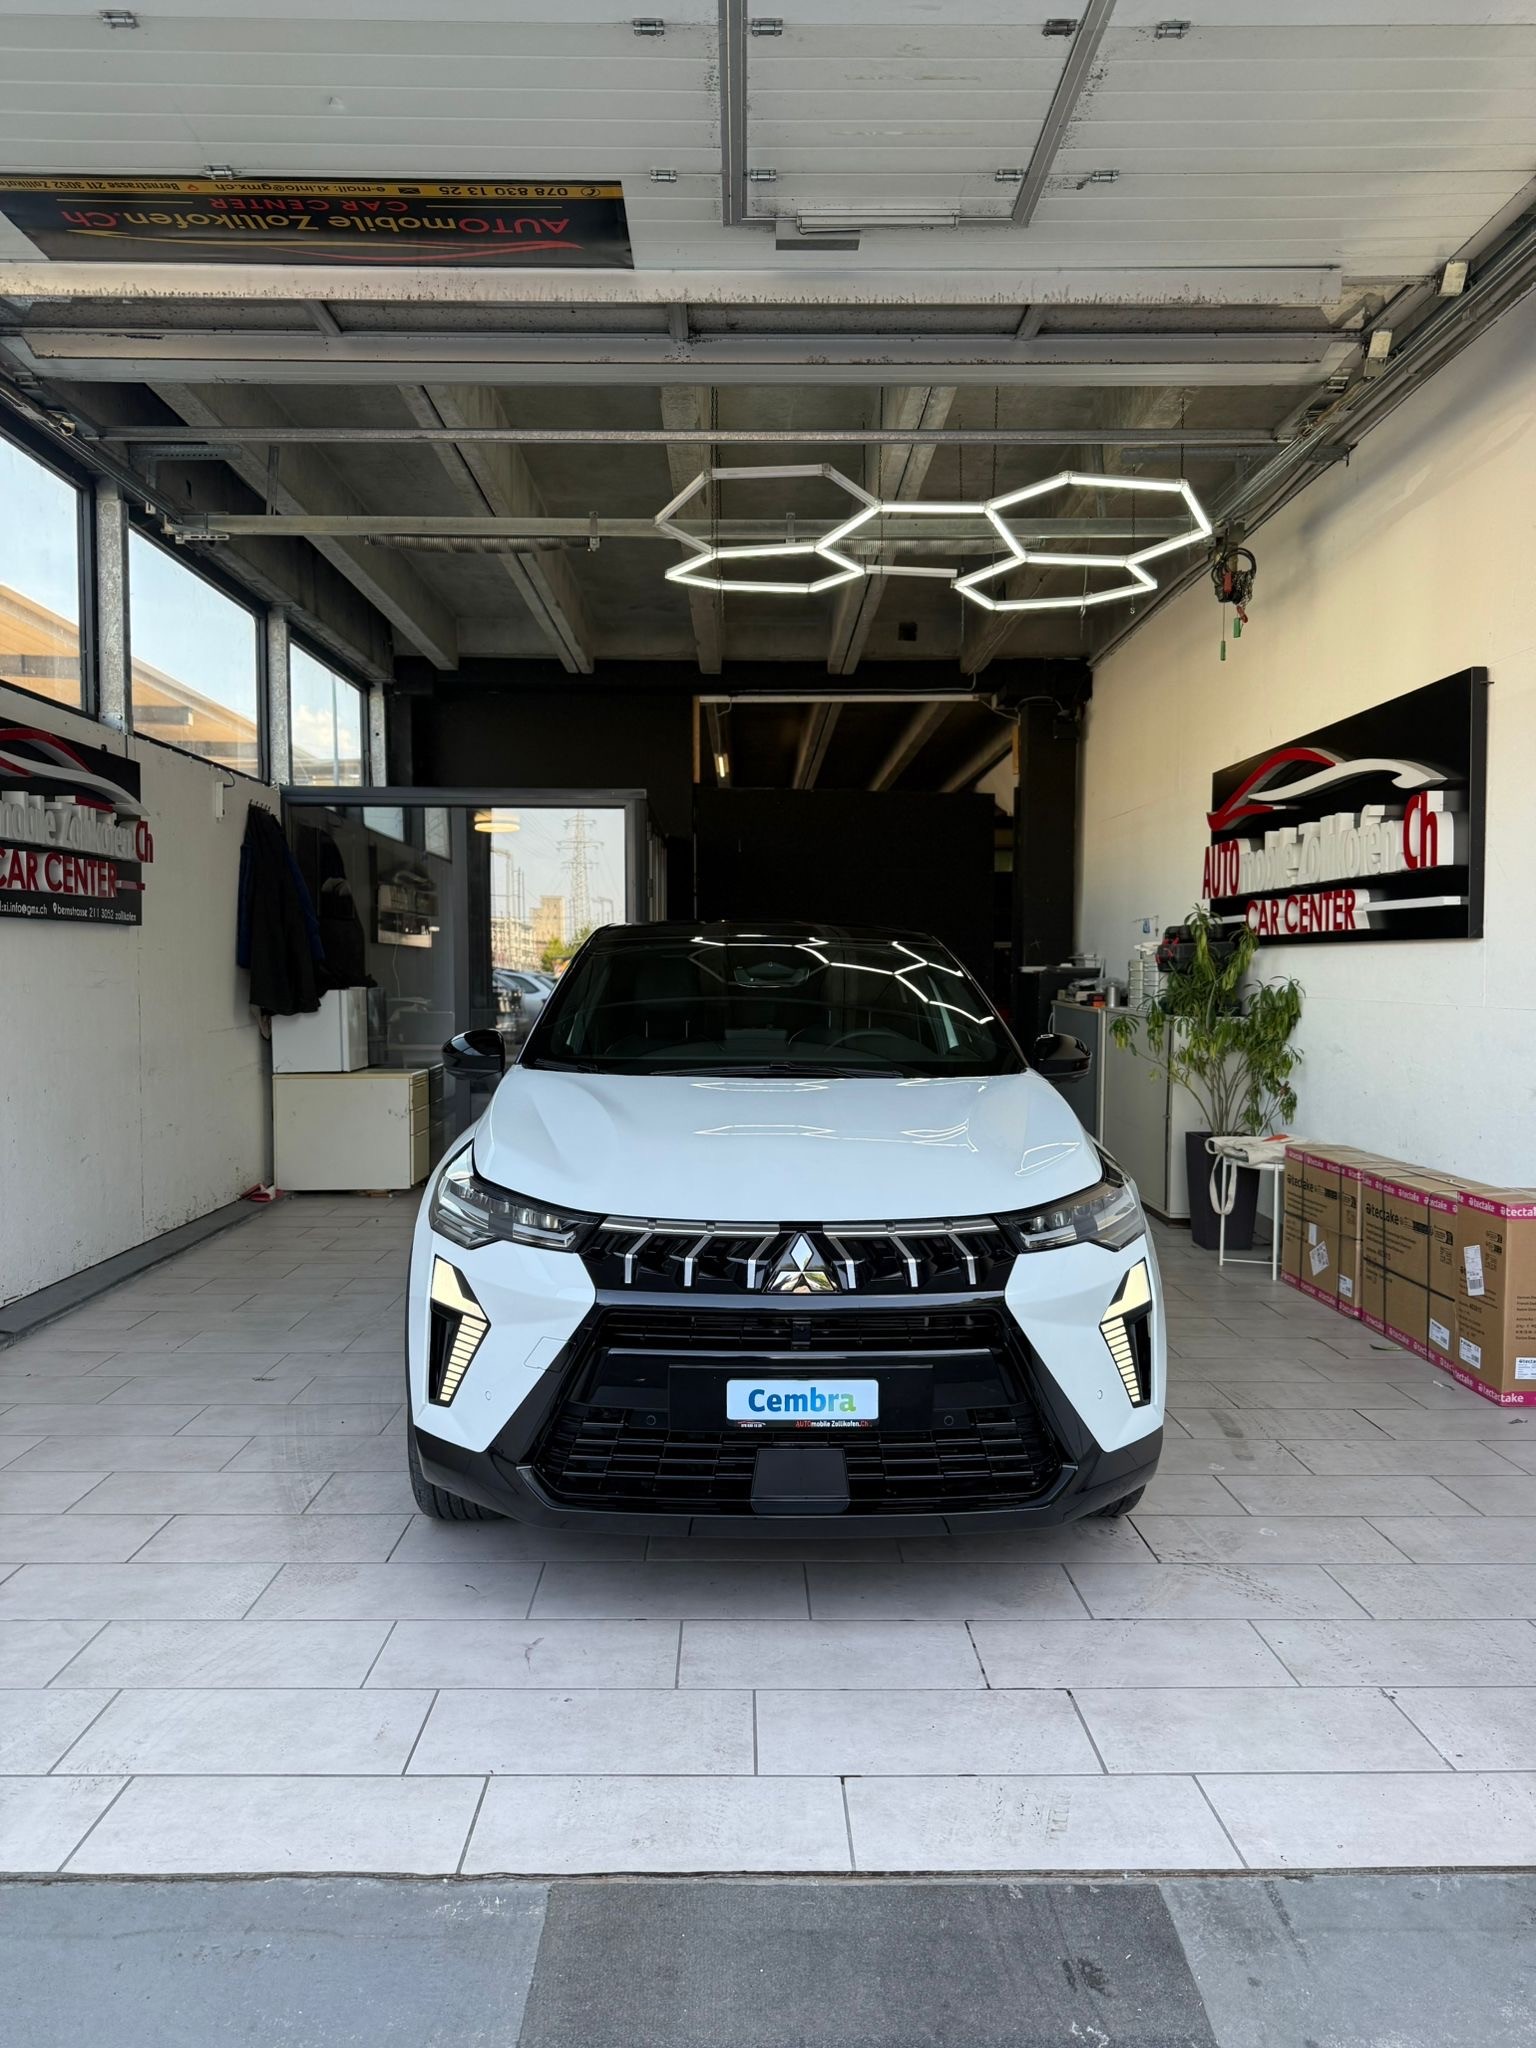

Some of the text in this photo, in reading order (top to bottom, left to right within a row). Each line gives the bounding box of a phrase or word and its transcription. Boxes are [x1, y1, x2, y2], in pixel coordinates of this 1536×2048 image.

[52, 180, 85, 190] 3052
[86, 181, 106, 190] 211
[108, 181, 181, 191] Bernstrasse
[439, 186, 568, 196] 078 830 13 25
[208, 198, 409, 212] CAR CENTER
[61, 210, 570, 234] AUTOmobile Zollikofen.Ch
[44, 850, 118, 899] CENTER
[1246, 888, 1357, 935] CAR CENTER
[748, 1386, 857, 1413] Cembra
